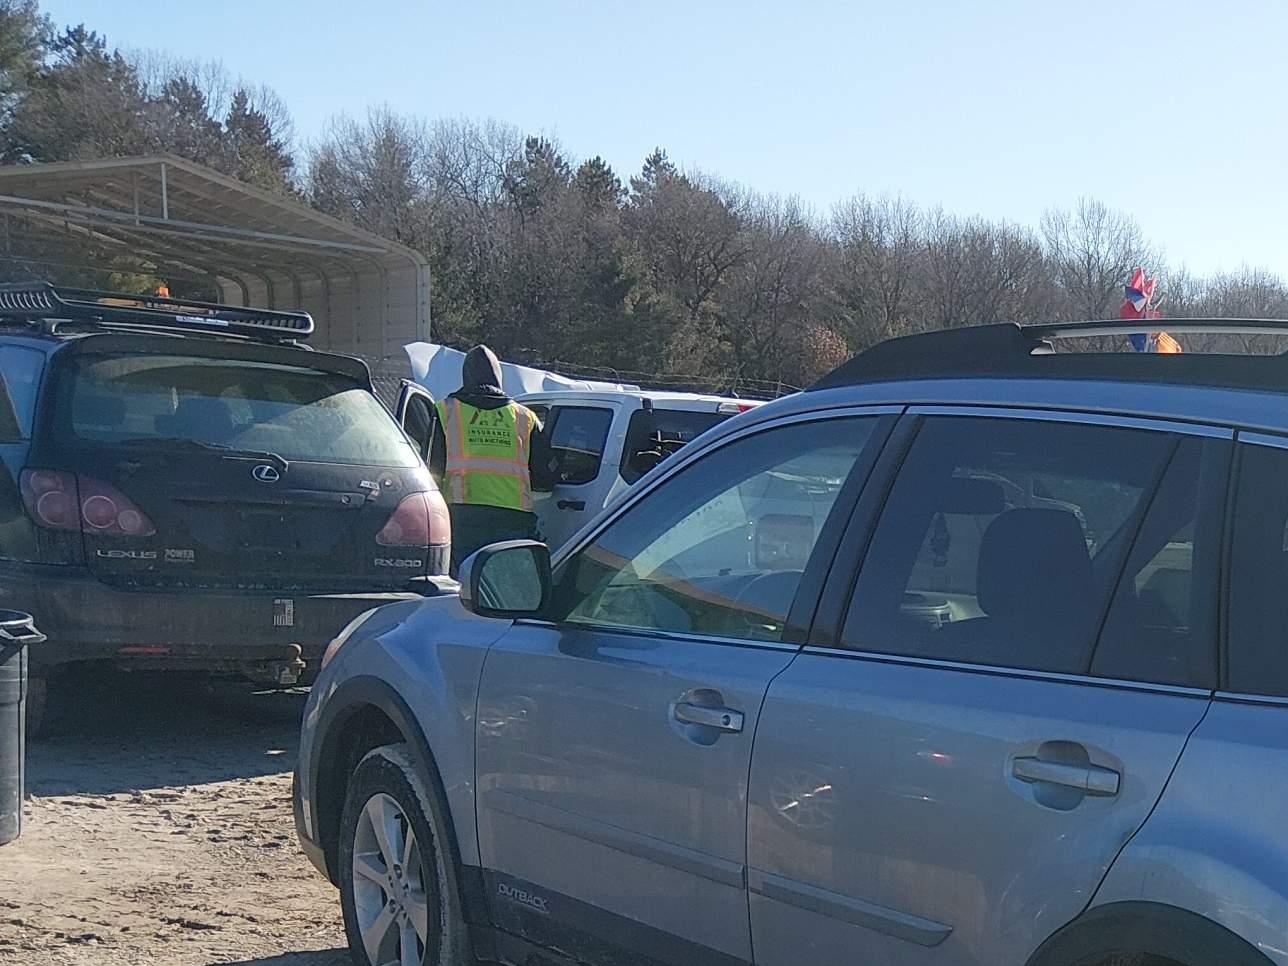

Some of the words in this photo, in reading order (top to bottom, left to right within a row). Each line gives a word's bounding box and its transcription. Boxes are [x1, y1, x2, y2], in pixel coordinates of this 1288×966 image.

[467, 429, 512, 438] INSURANCE
[96, 549, 158, 560] LEXUS
[498, 883, 548, 911] OUTBACK
